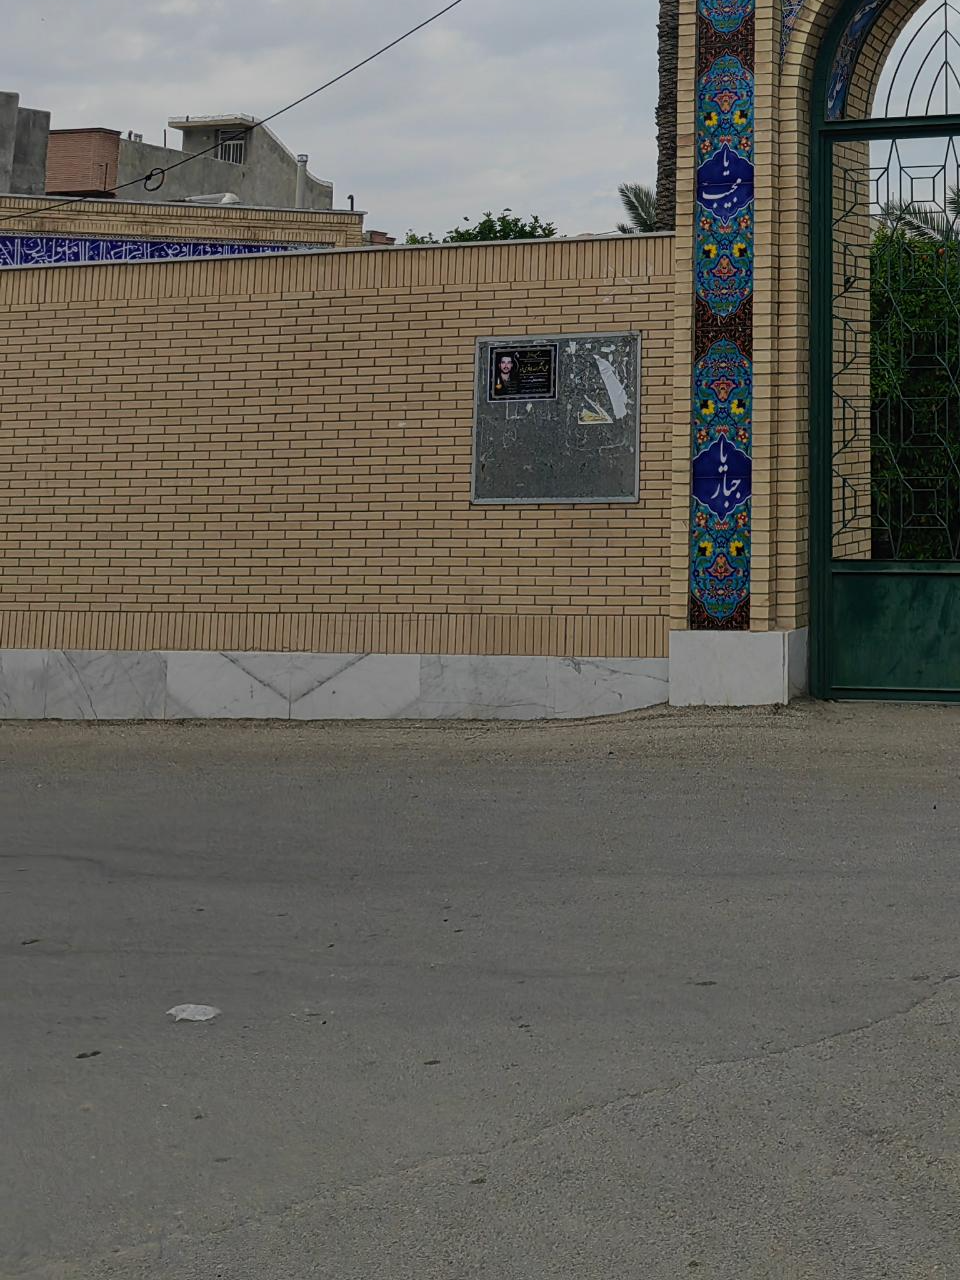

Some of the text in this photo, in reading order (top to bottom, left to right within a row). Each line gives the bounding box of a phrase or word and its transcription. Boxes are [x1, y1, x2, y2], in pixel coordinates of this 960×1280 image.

[723, 149, 730, 176] یا
[718, 439, 728, 473] یا
[710, 473, 742, 508] جبار
